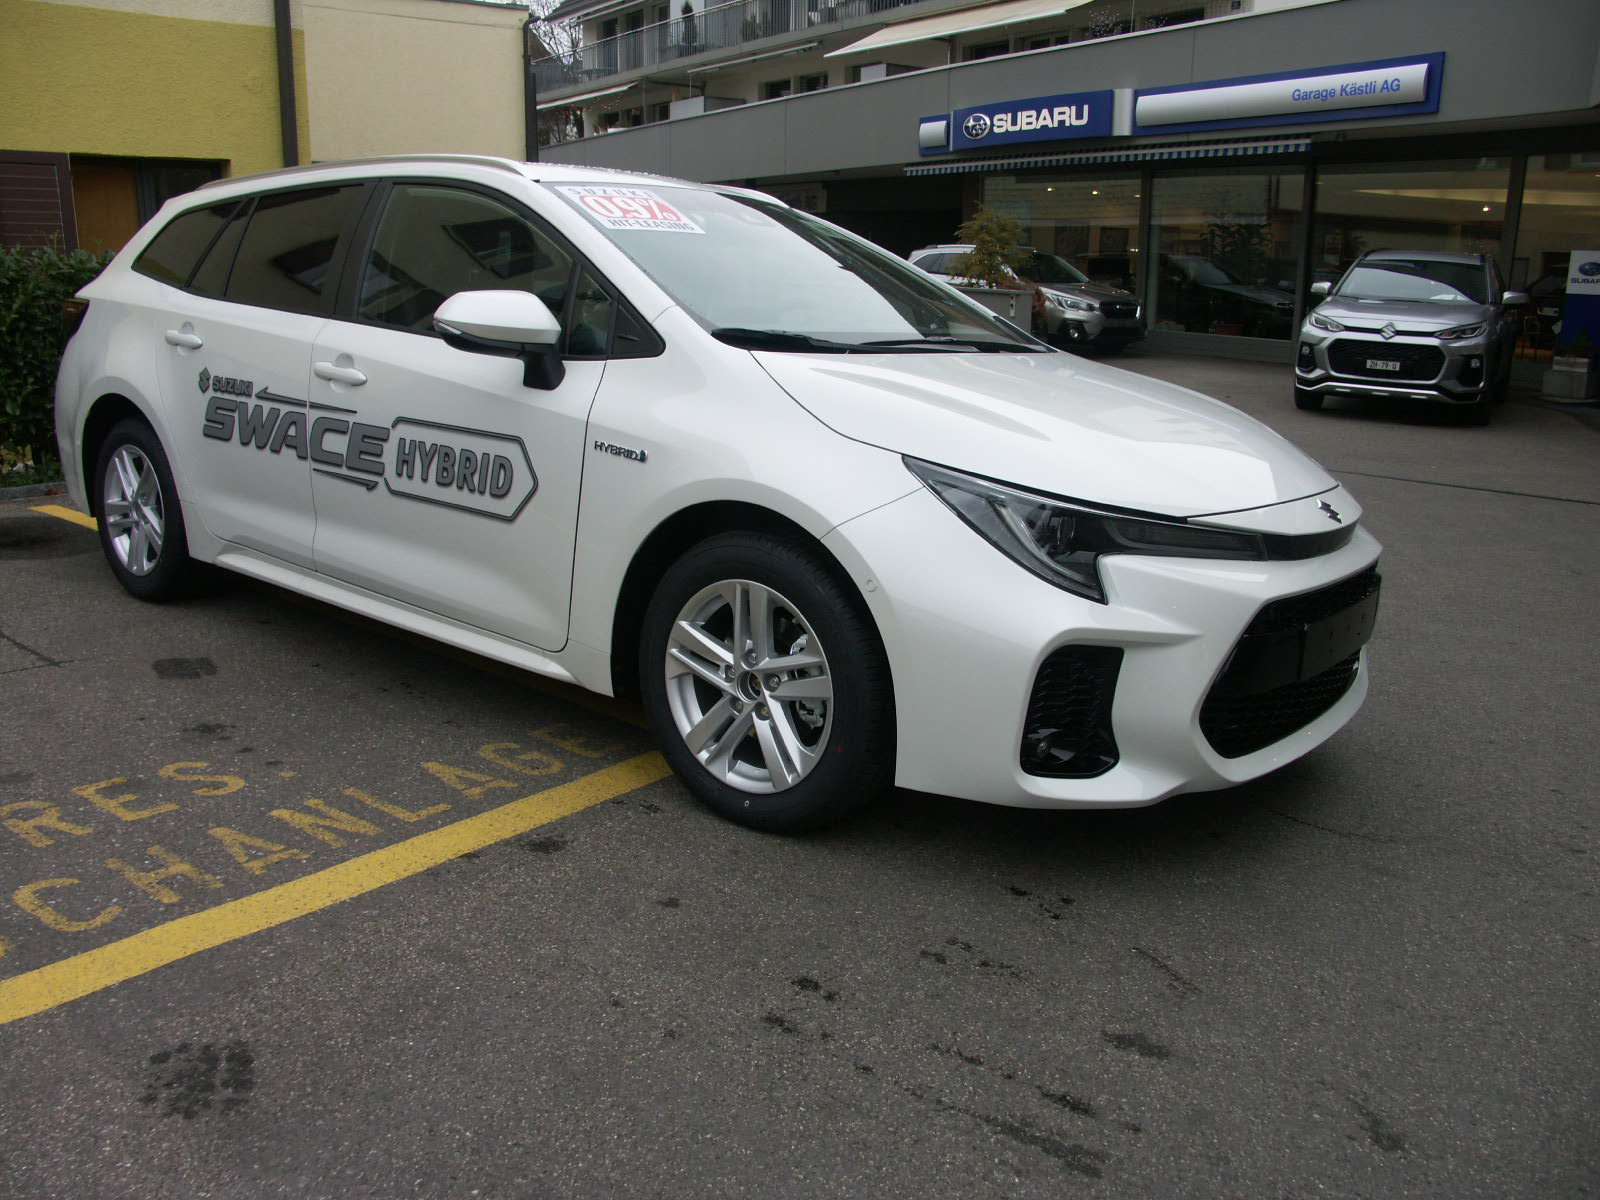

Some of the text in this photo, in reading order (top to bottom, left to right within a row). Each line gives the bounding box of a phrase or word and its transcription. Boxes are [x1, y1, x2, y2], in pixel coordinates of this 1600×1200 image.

[1292, 78, 1401, 101] Garage Kästli AG
[993, 104, 1089, 133] SUBARU
[567, 187, 654, 198] SUZUKI
[607, 218, 696, 232] HIT-LEASING
[212, 375, 254, 398] SUZUKI
[203, 396, 514, 498] SWACE HYBRID
[594, 440, 639, 461] HYBRID
[0, 721, 626, 958] CHANLAGE
